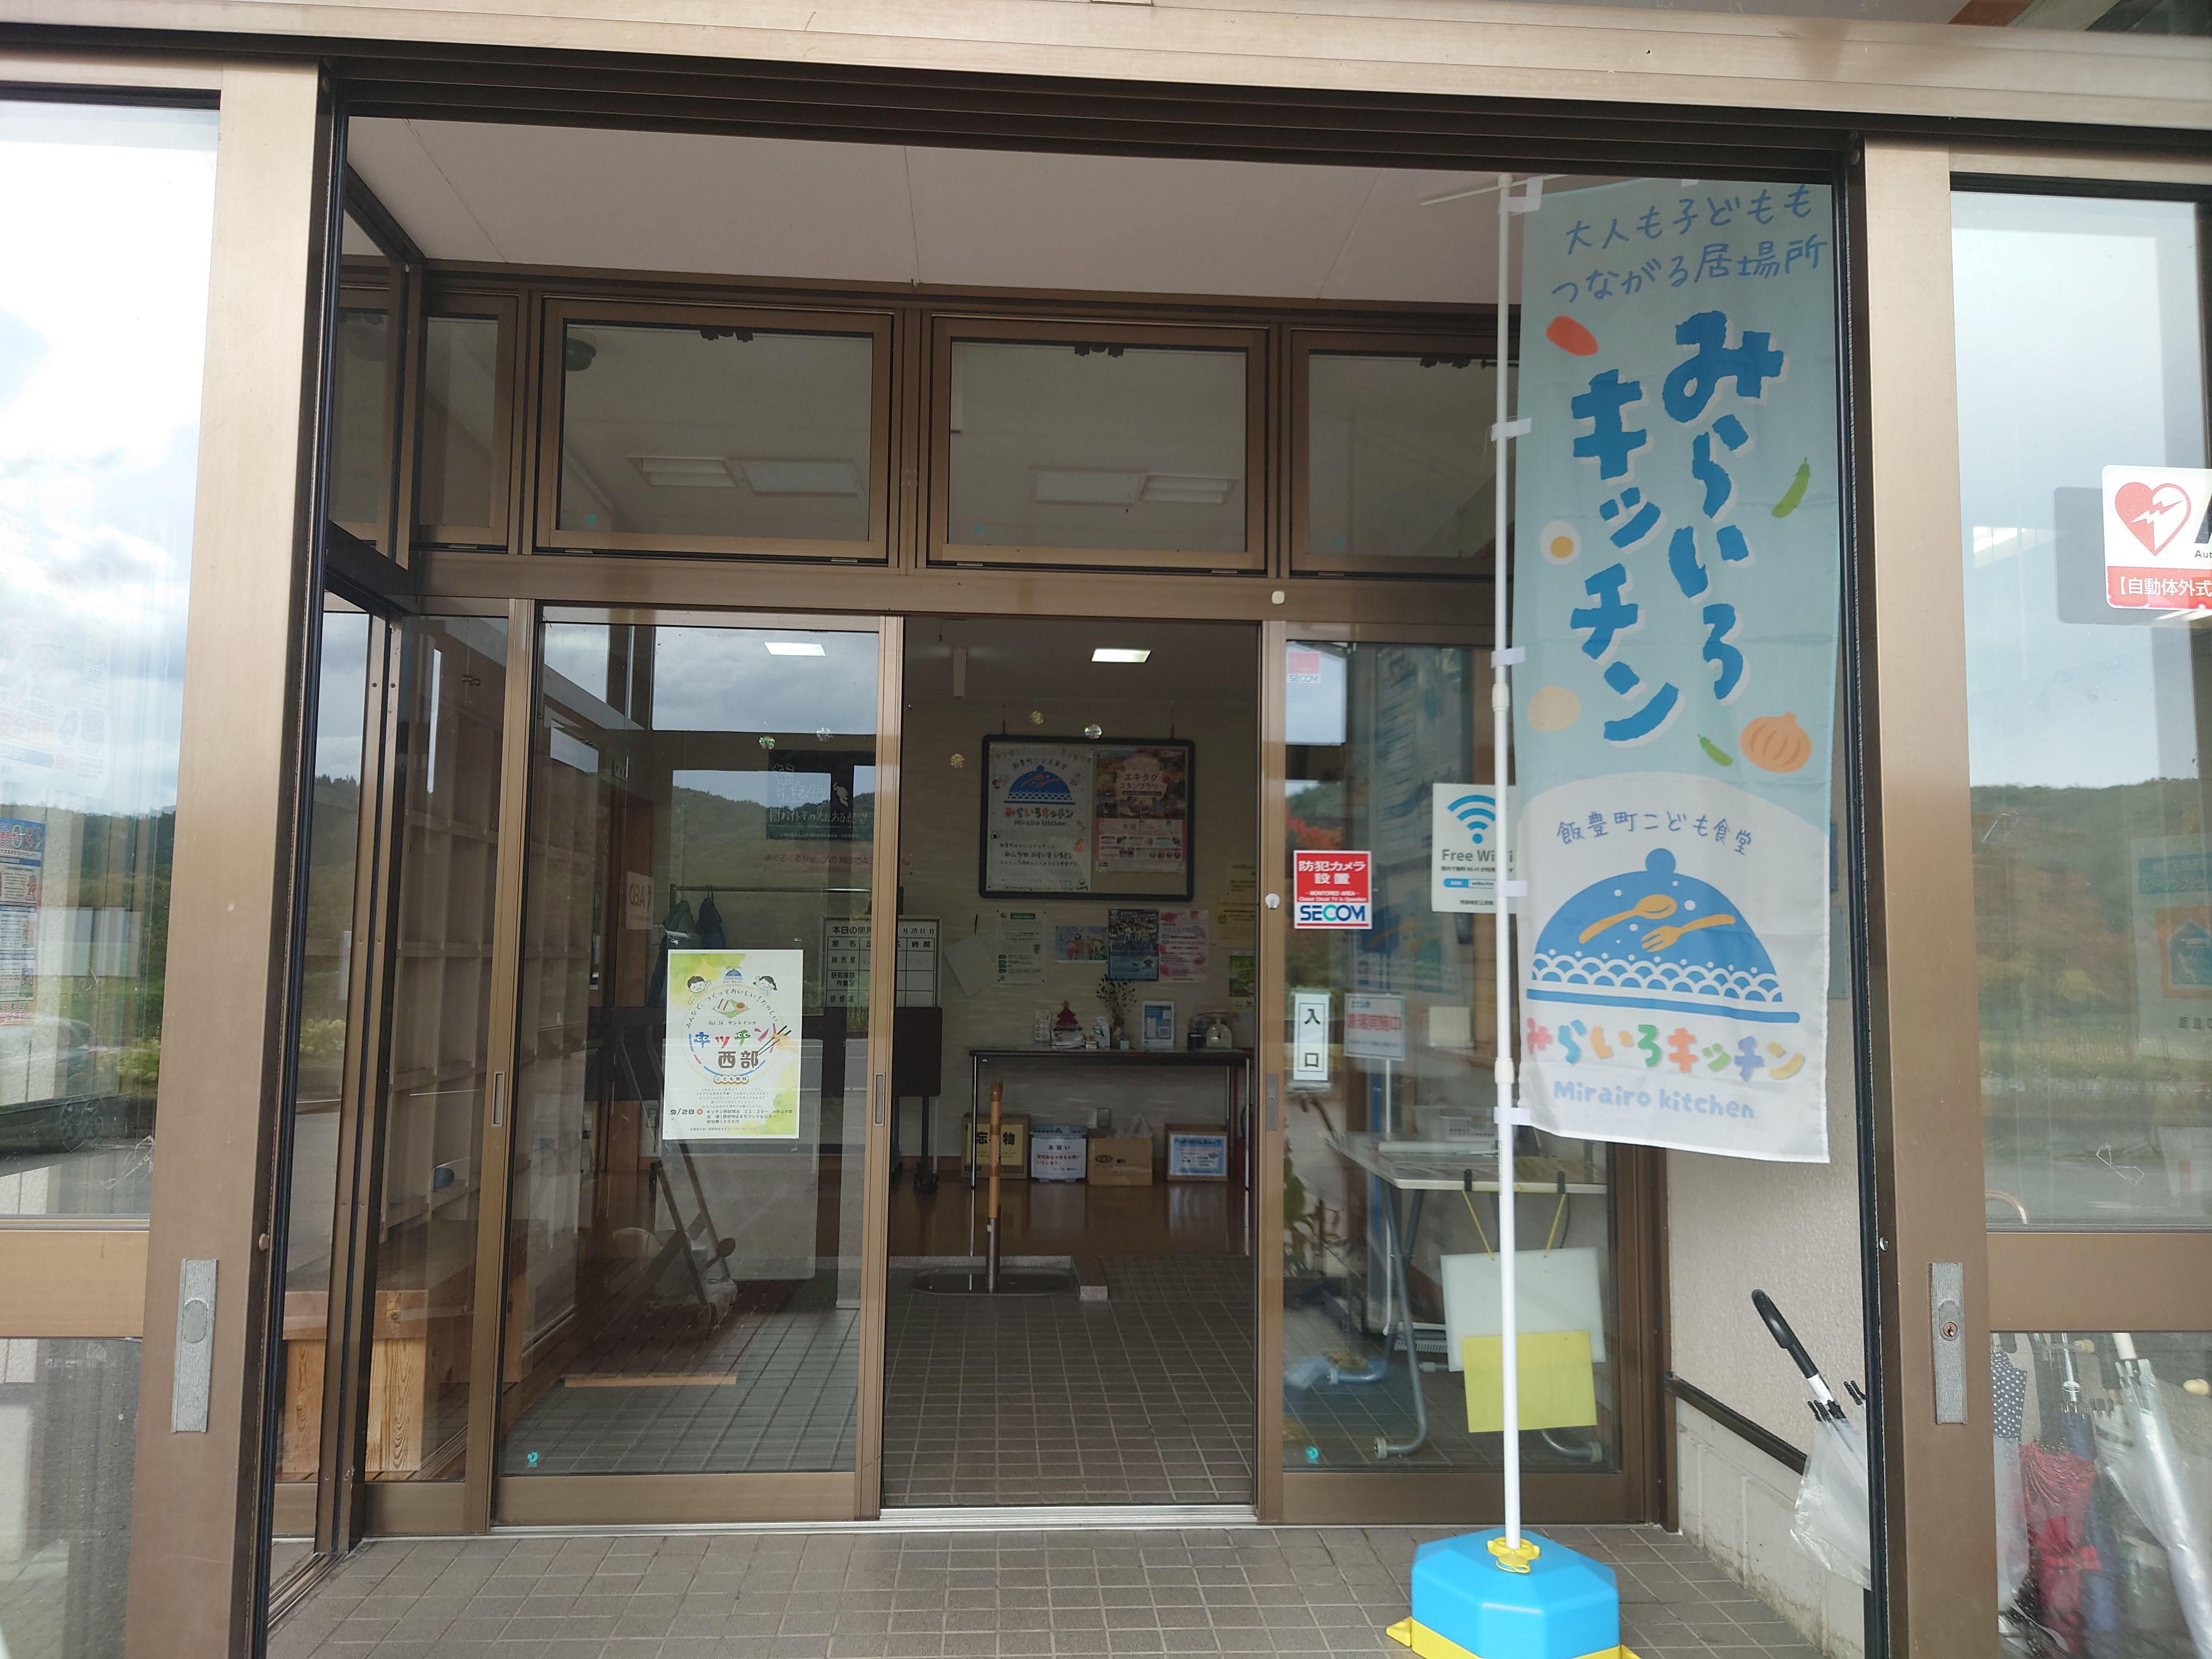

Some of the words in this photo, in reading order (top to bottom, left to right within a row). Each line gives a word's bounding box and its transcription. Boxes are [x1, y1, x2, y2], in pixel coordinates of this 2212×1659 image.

[1566, 184, 1812, 255] 大人も子どもも
[1552, 234, 1827, 303] つながる居場所
[1662, 310, 1785, 701] みらいろ
[1570, 369, 1679, 742] キッチン
[1556, 811, 1752, 856] 飯豊町こども食堂
[1299, 860, 1367, 872] 防犯カメラ
[1442, 849, 1473, 861] Free
[1476, 850, 1513, 862] Wii
[1314, 873, 1350, 884] 設置
[1300, 905, 1365, 921] SECOM
[694, 1028, 769, 1048] キッチン
[1304, 1008, 1321, 1068] 入口
[718, 1051, 759, 1069] 西部
[1553, 1081, 1652, 1108] Mirairo
[1659, 1092, 1754, 1119] kitchen
[977, 1131, 1015, 1146] 忘物
